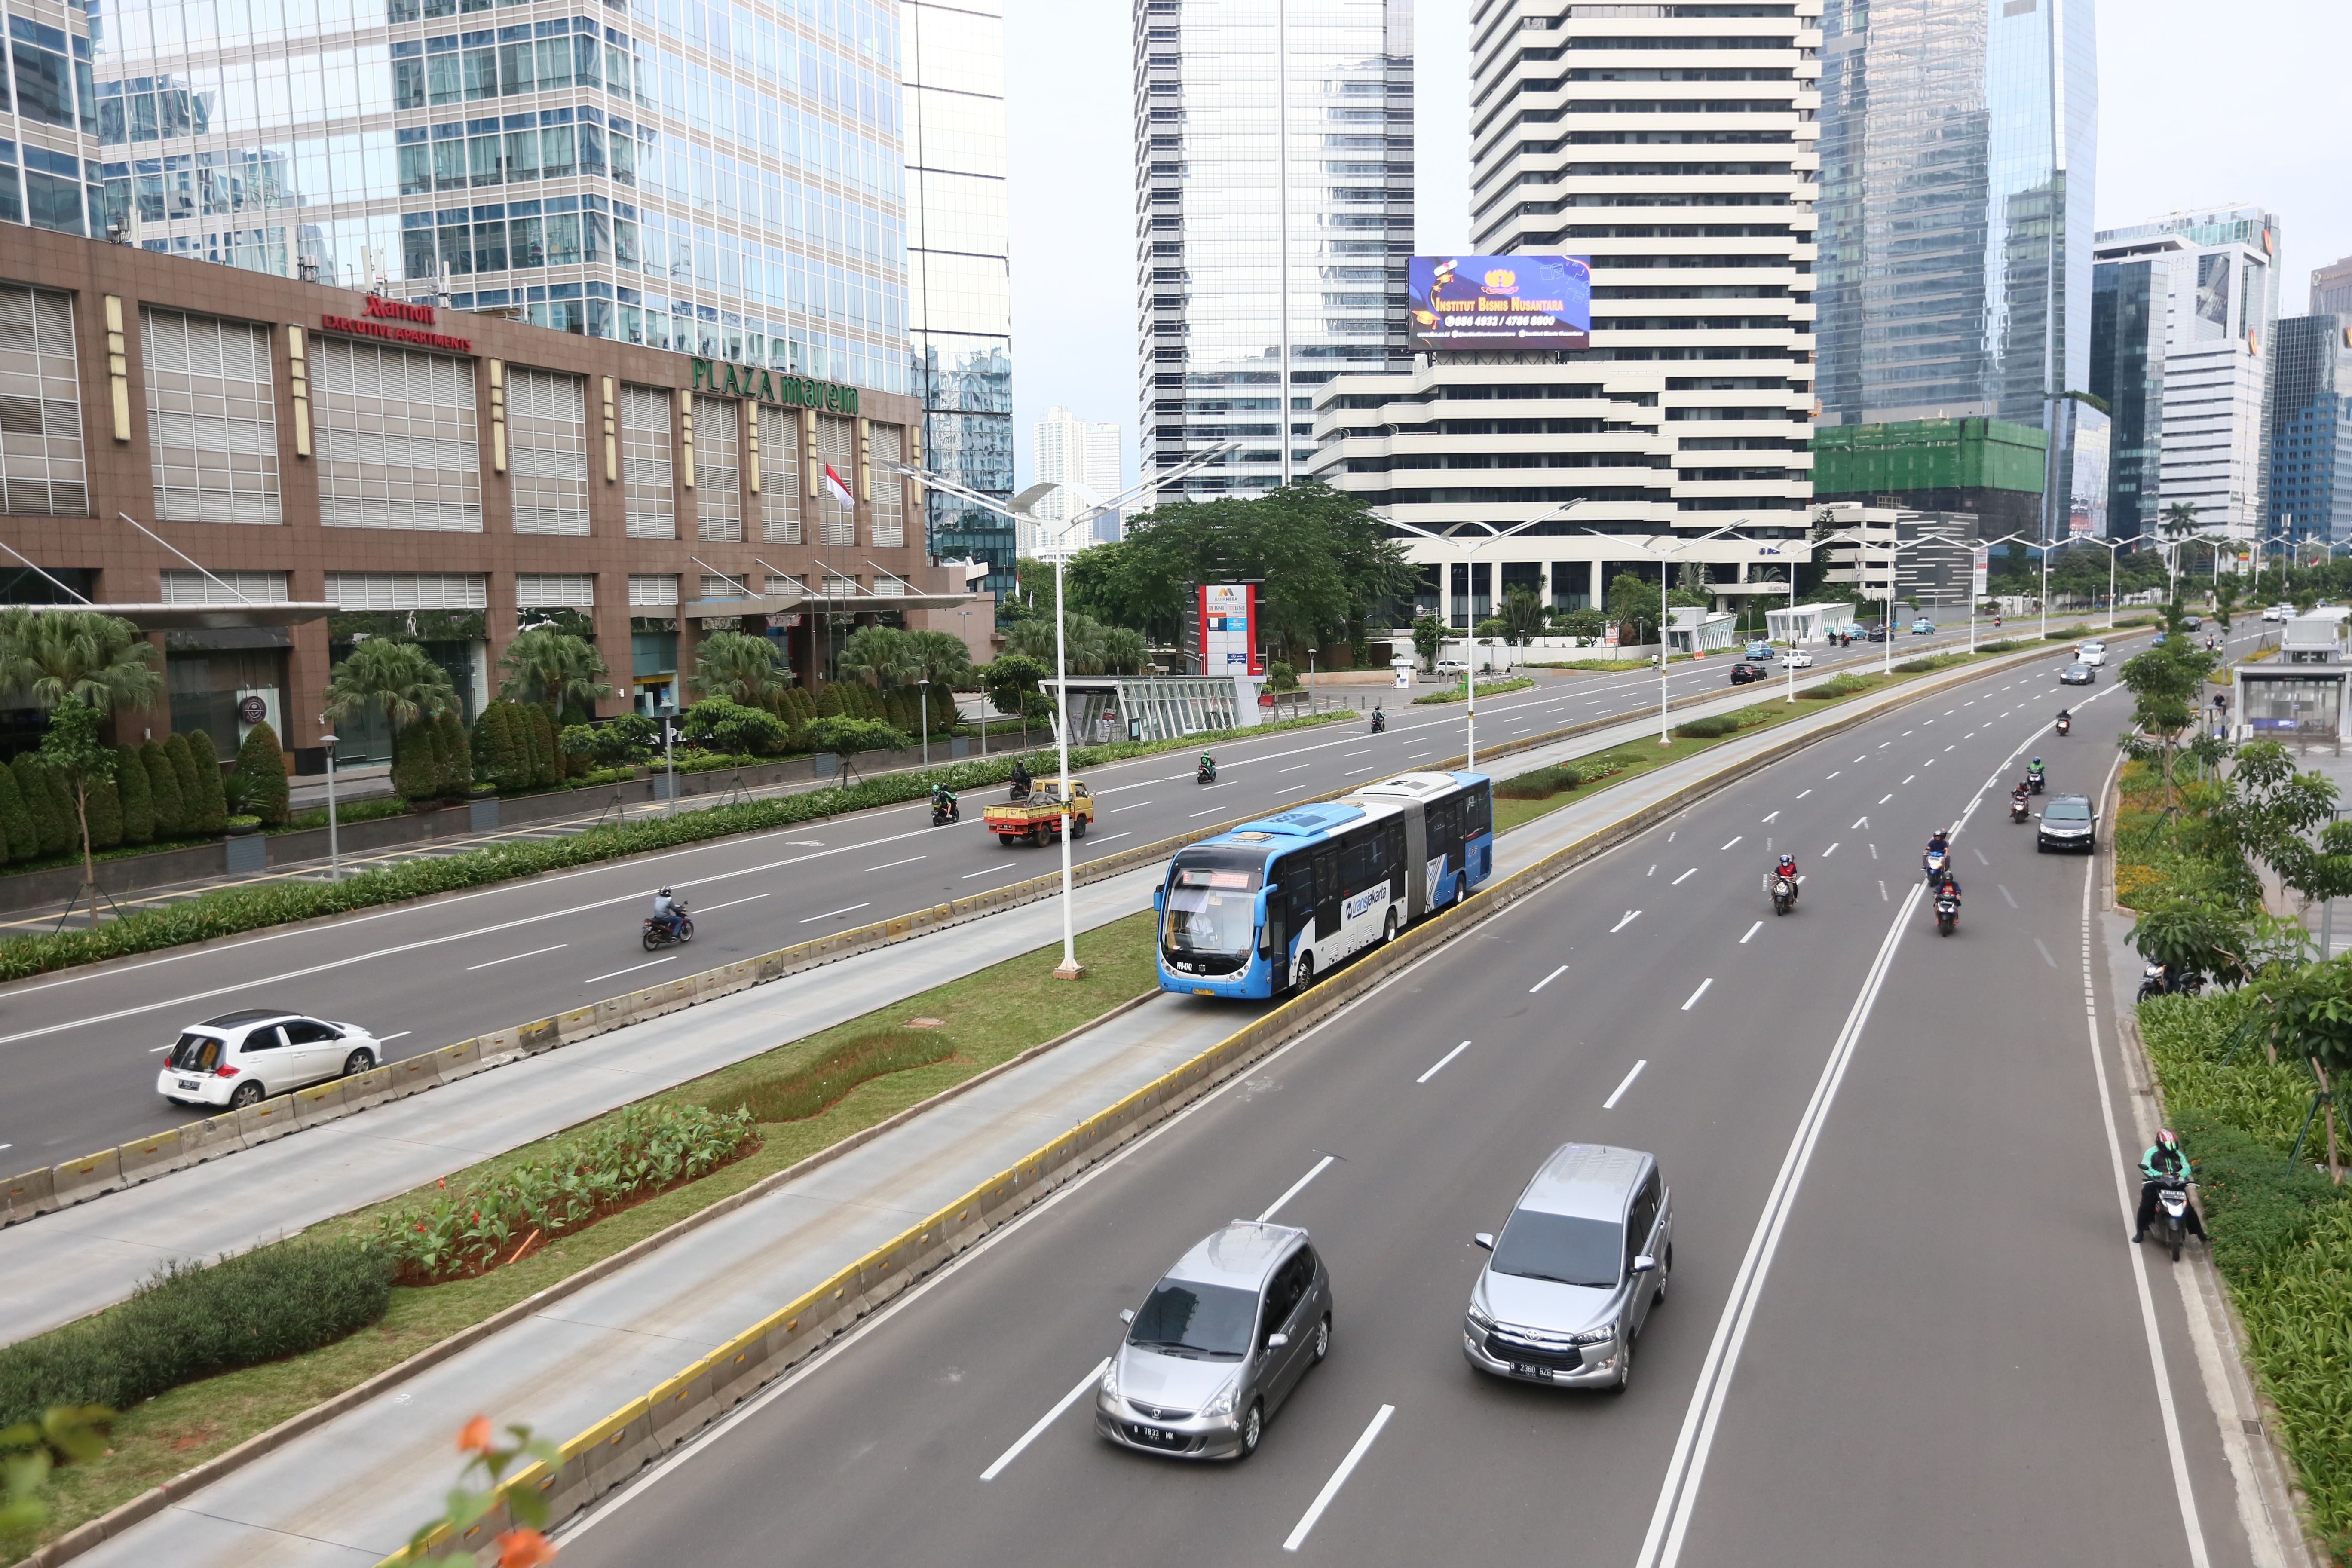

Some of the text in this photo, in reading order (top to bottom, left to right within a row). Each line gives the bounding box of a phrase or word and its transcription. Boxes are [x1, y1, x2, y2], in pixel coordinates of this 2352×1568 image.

[363, 295, 436, 325] Marriott
[323, 314, 472, 351] EXECUTIVE APARTMENTS
[692, 357, 775, 401] PLAZA
[1352, 885, 1386, 918] transjakarta
[1177, 961, 1192, 971] PPD-0742
[1520, 1364, 1535, 1373] 2360
[1539, 1367, 1551, 1376] BZB
[1165, 1431, 1174, 1440] MK
